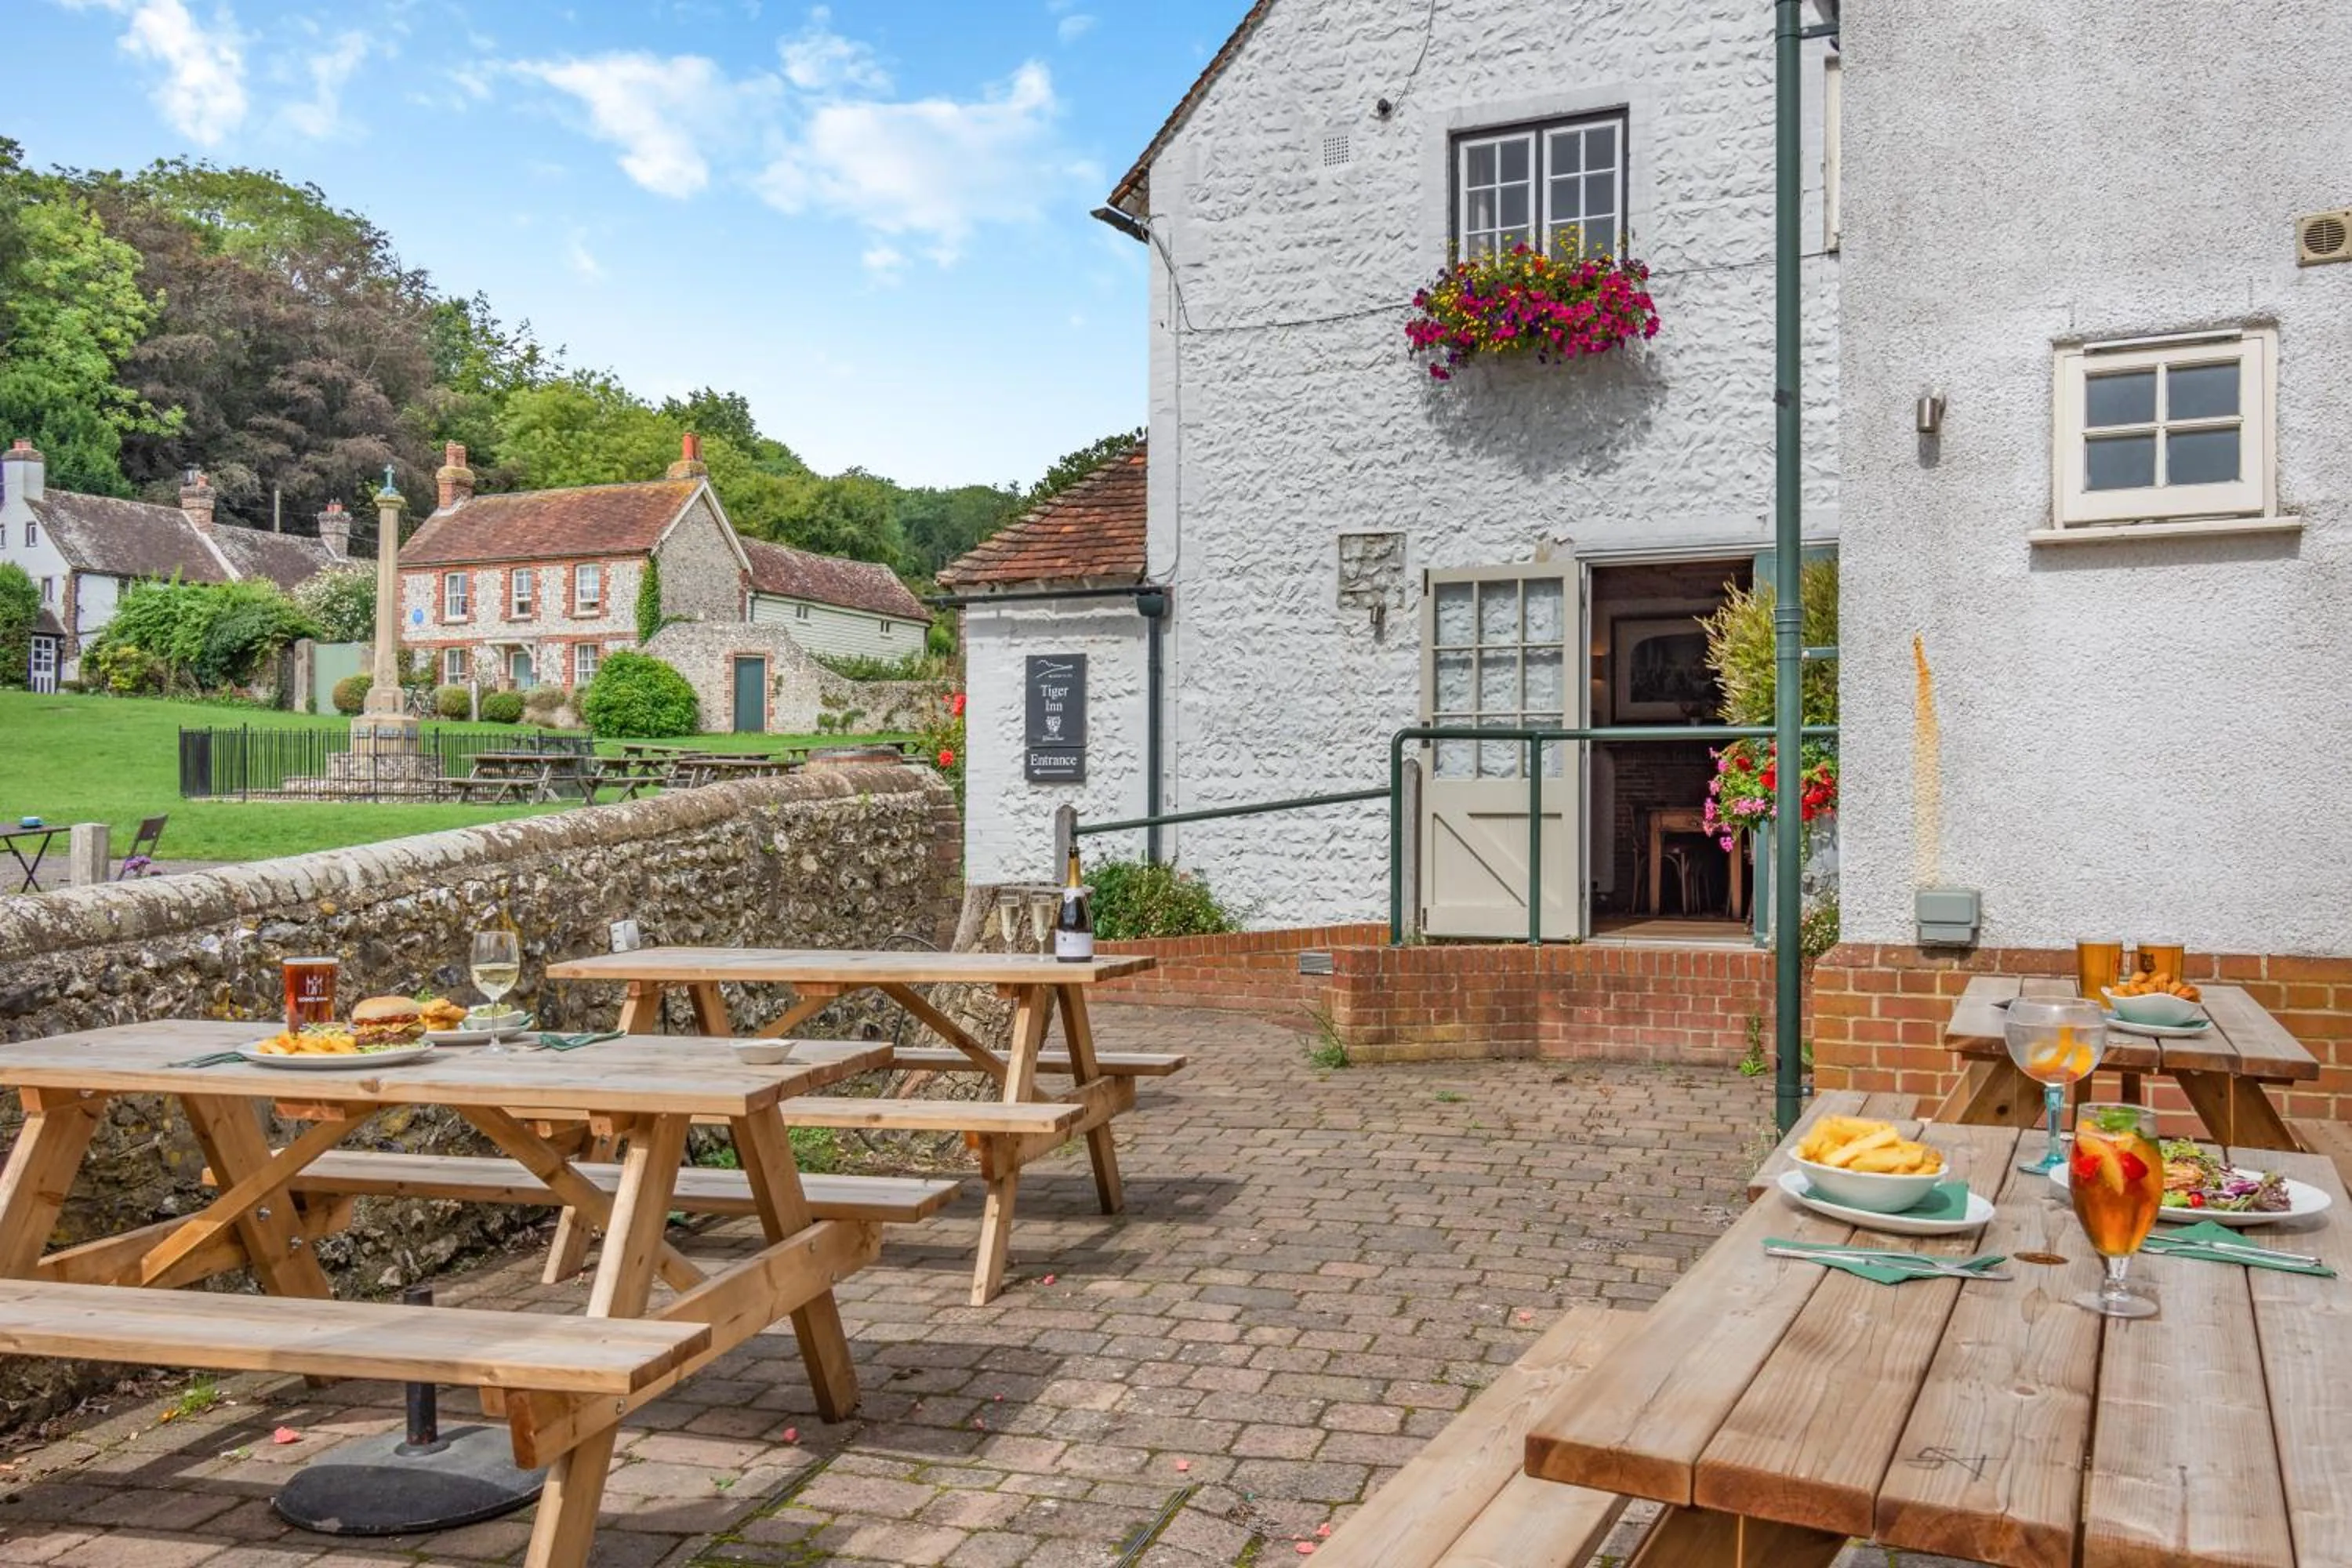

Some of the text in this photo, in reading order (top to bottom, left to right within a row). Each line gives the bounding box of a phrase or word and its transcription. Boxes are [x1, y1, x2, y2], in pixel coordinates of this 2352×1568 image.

[1040, 684, 1069, 699] Tiger
[1045, 699, 1063, 712] Inn
[1030, 753, 1077, 766] Entrance
